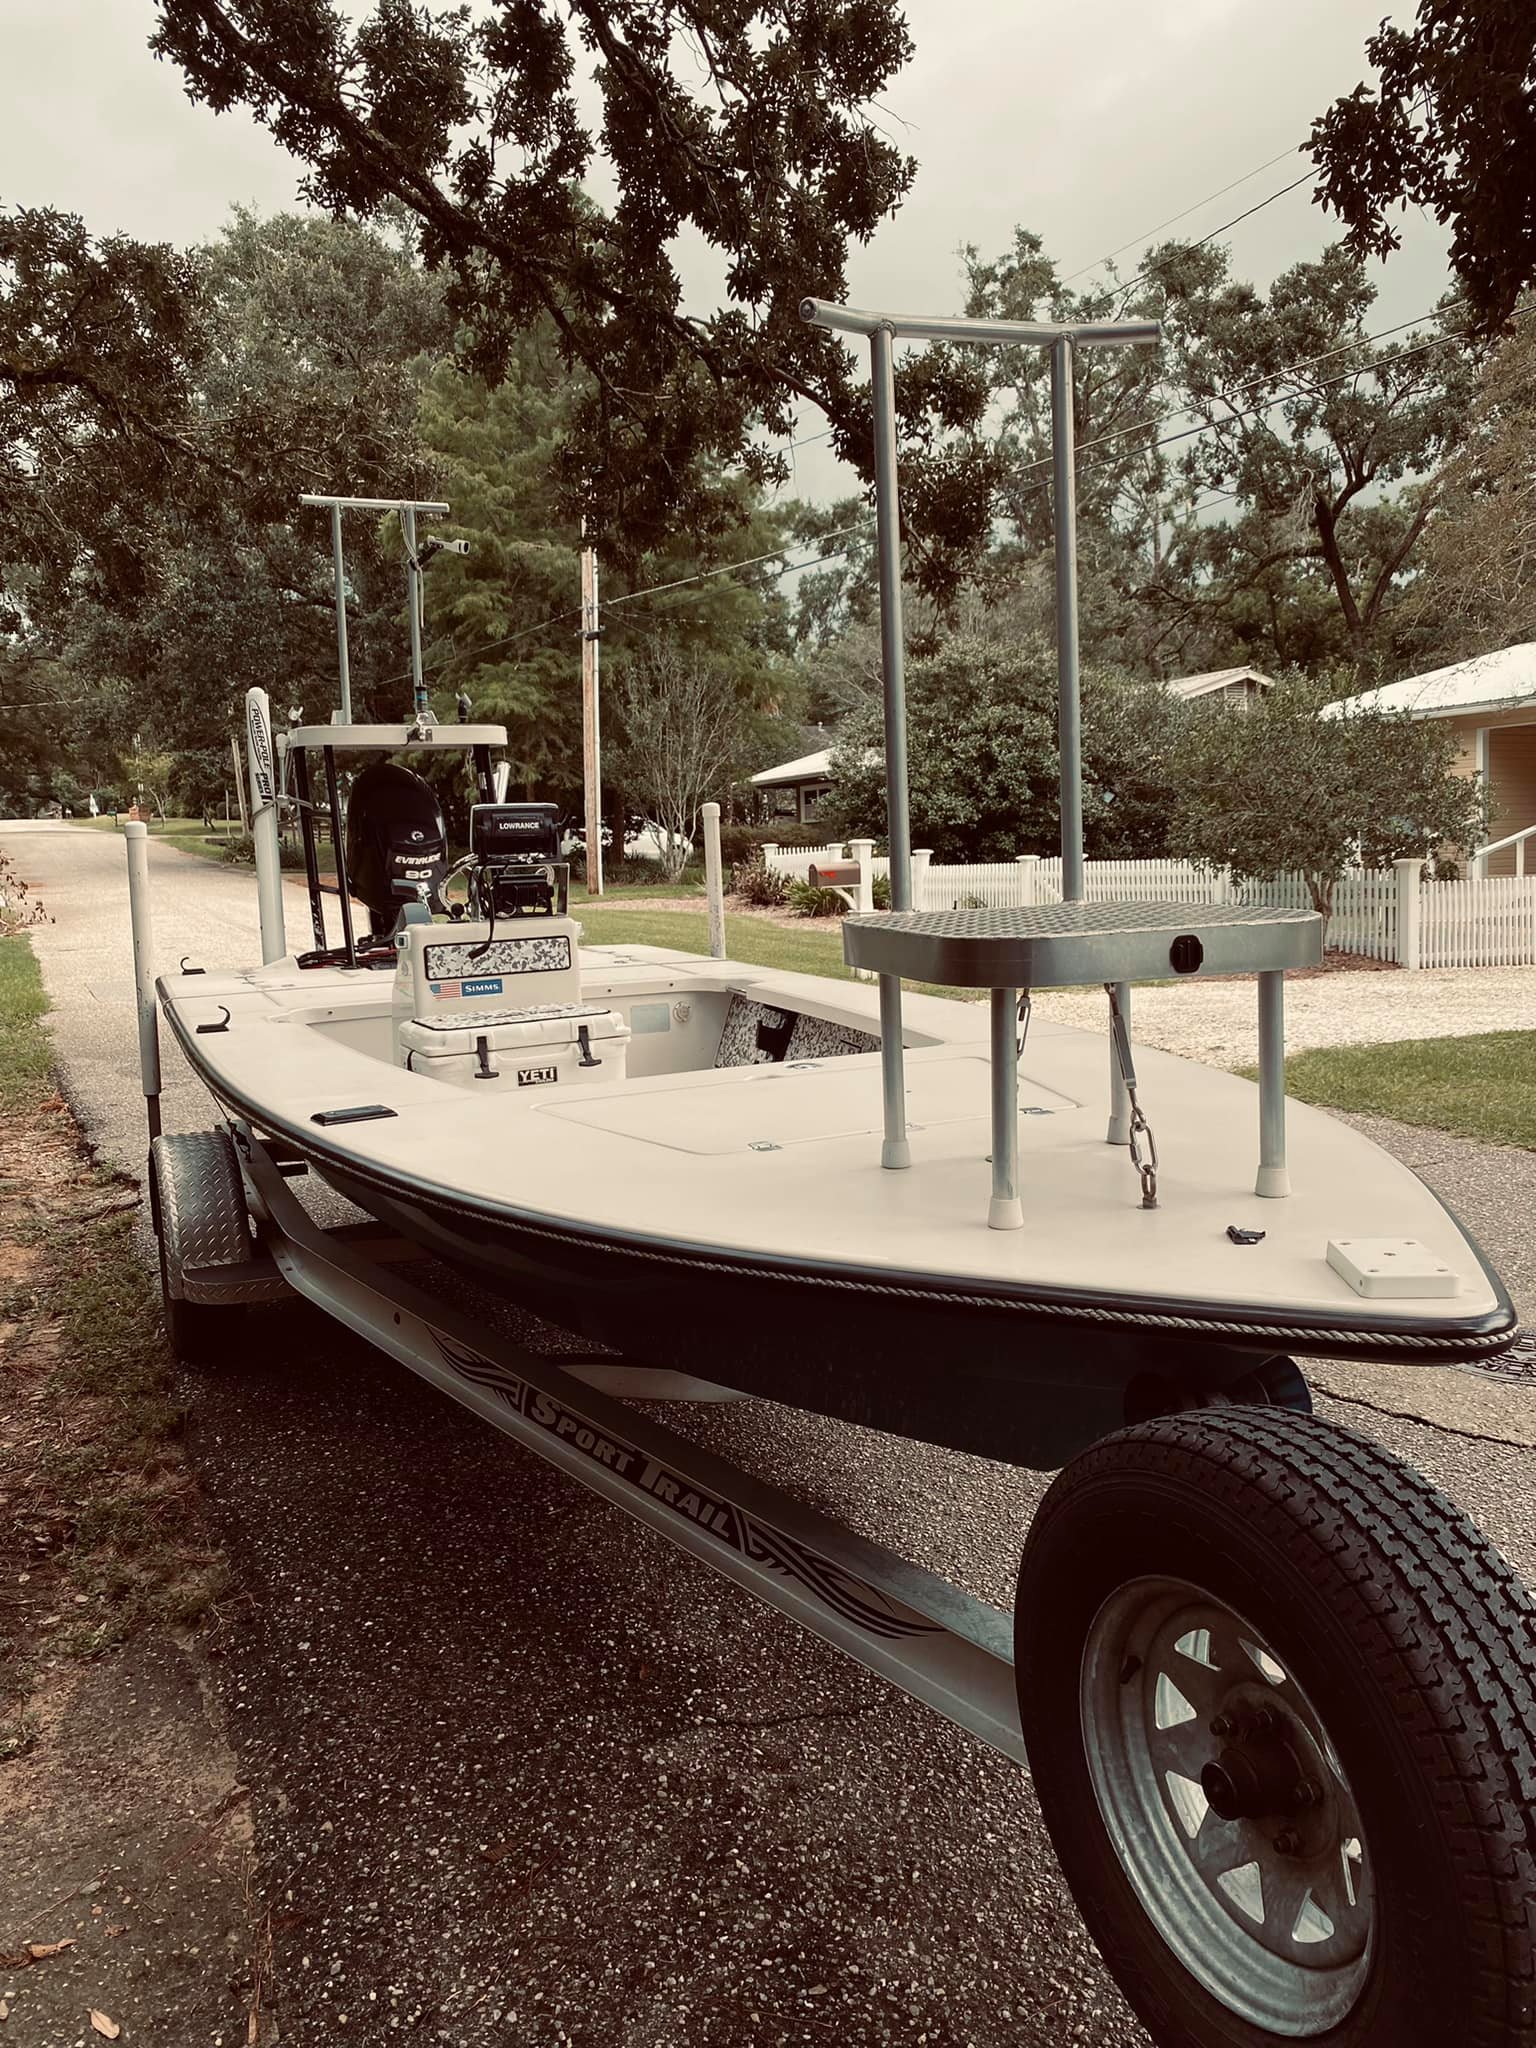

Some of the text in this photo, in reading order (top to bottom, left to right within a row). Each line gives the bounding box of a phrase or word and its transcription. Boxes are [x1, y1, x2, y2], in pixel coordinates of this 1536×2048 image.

[252, 708, 270, 769] POWER-POLE
[260, 773, 272, 794] PRO
[499, 822, 540, 830] LOWRANCE
[395, 852, 441, 865] EVINRUDE
[405, 869, 433, 879] 90
[465, 983, 499, 993] SIMMS
[519, 1068, 555, 1082] YETI
[531, 1393, 730, 1538] SPORT TRAIL
